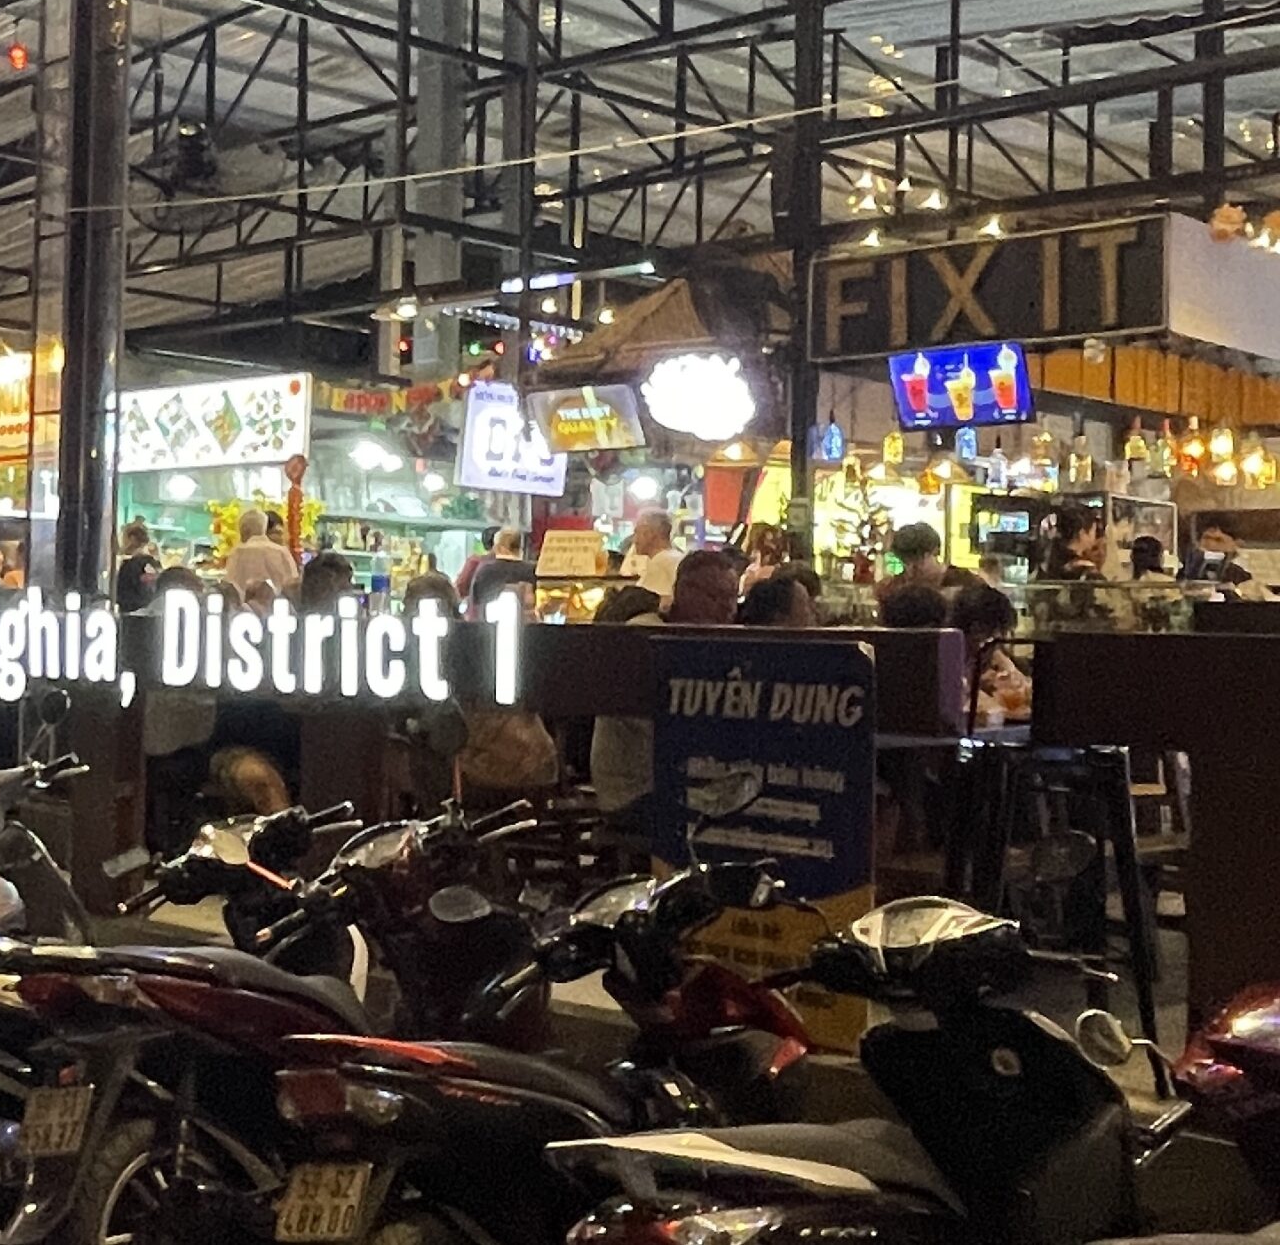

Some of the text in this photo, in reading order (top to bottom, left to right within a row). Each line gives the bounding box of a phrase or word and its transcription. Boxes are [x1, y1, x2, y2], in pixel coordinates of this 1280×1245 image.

[824, 225, 1138, 354] FIX IT
[162, 589, 449, 701] District
[485, 591, 518, 704] 1
